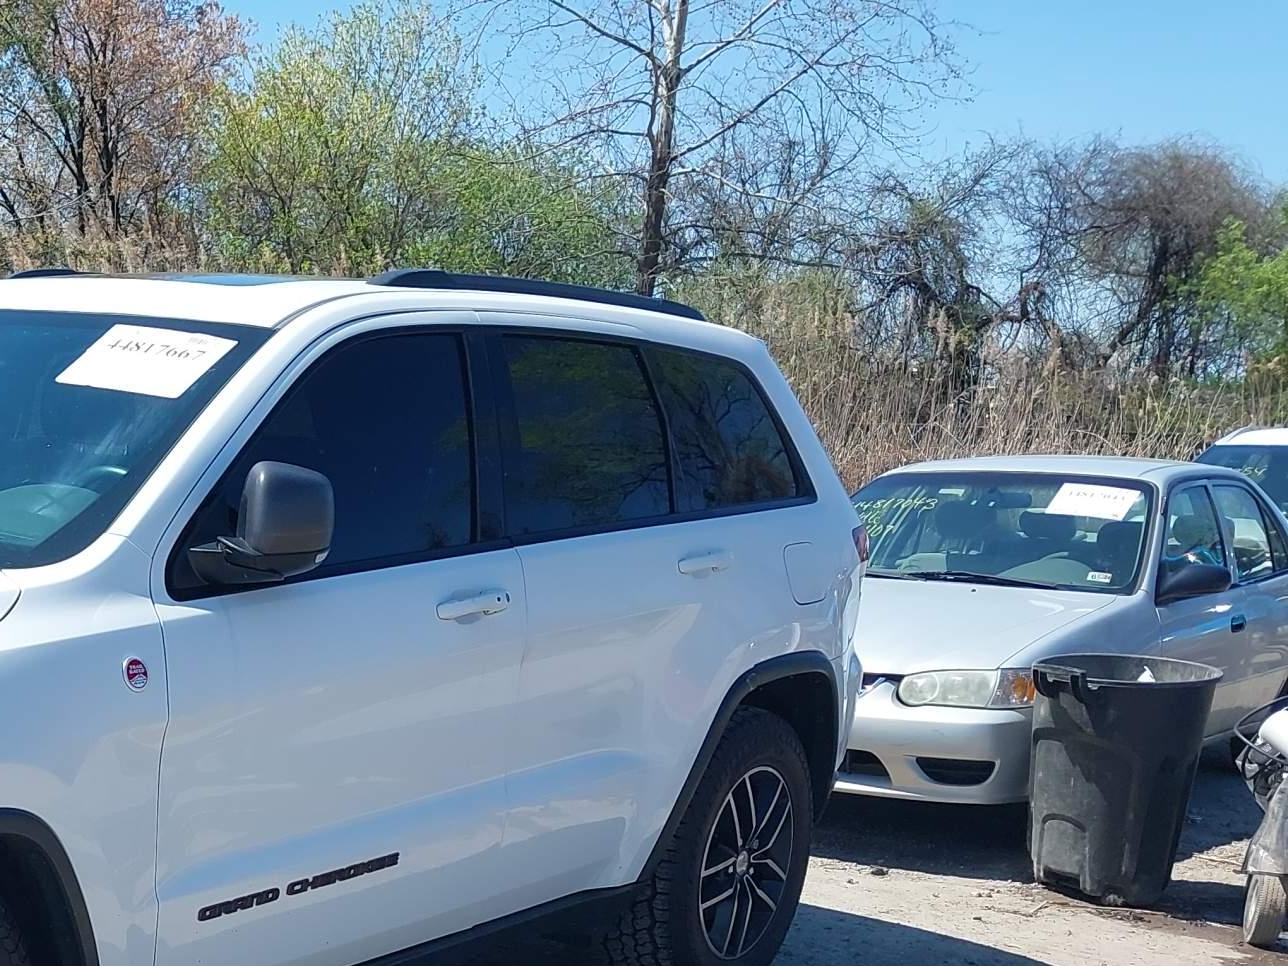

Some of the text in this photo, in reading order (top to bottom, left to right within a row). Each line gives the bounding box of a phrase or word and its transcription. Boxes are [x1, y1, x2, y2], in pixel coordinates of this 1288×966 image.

[107, 338, 207, 361] 44817667
[197, 851, 401, 922] GRAND CHEROKEE
